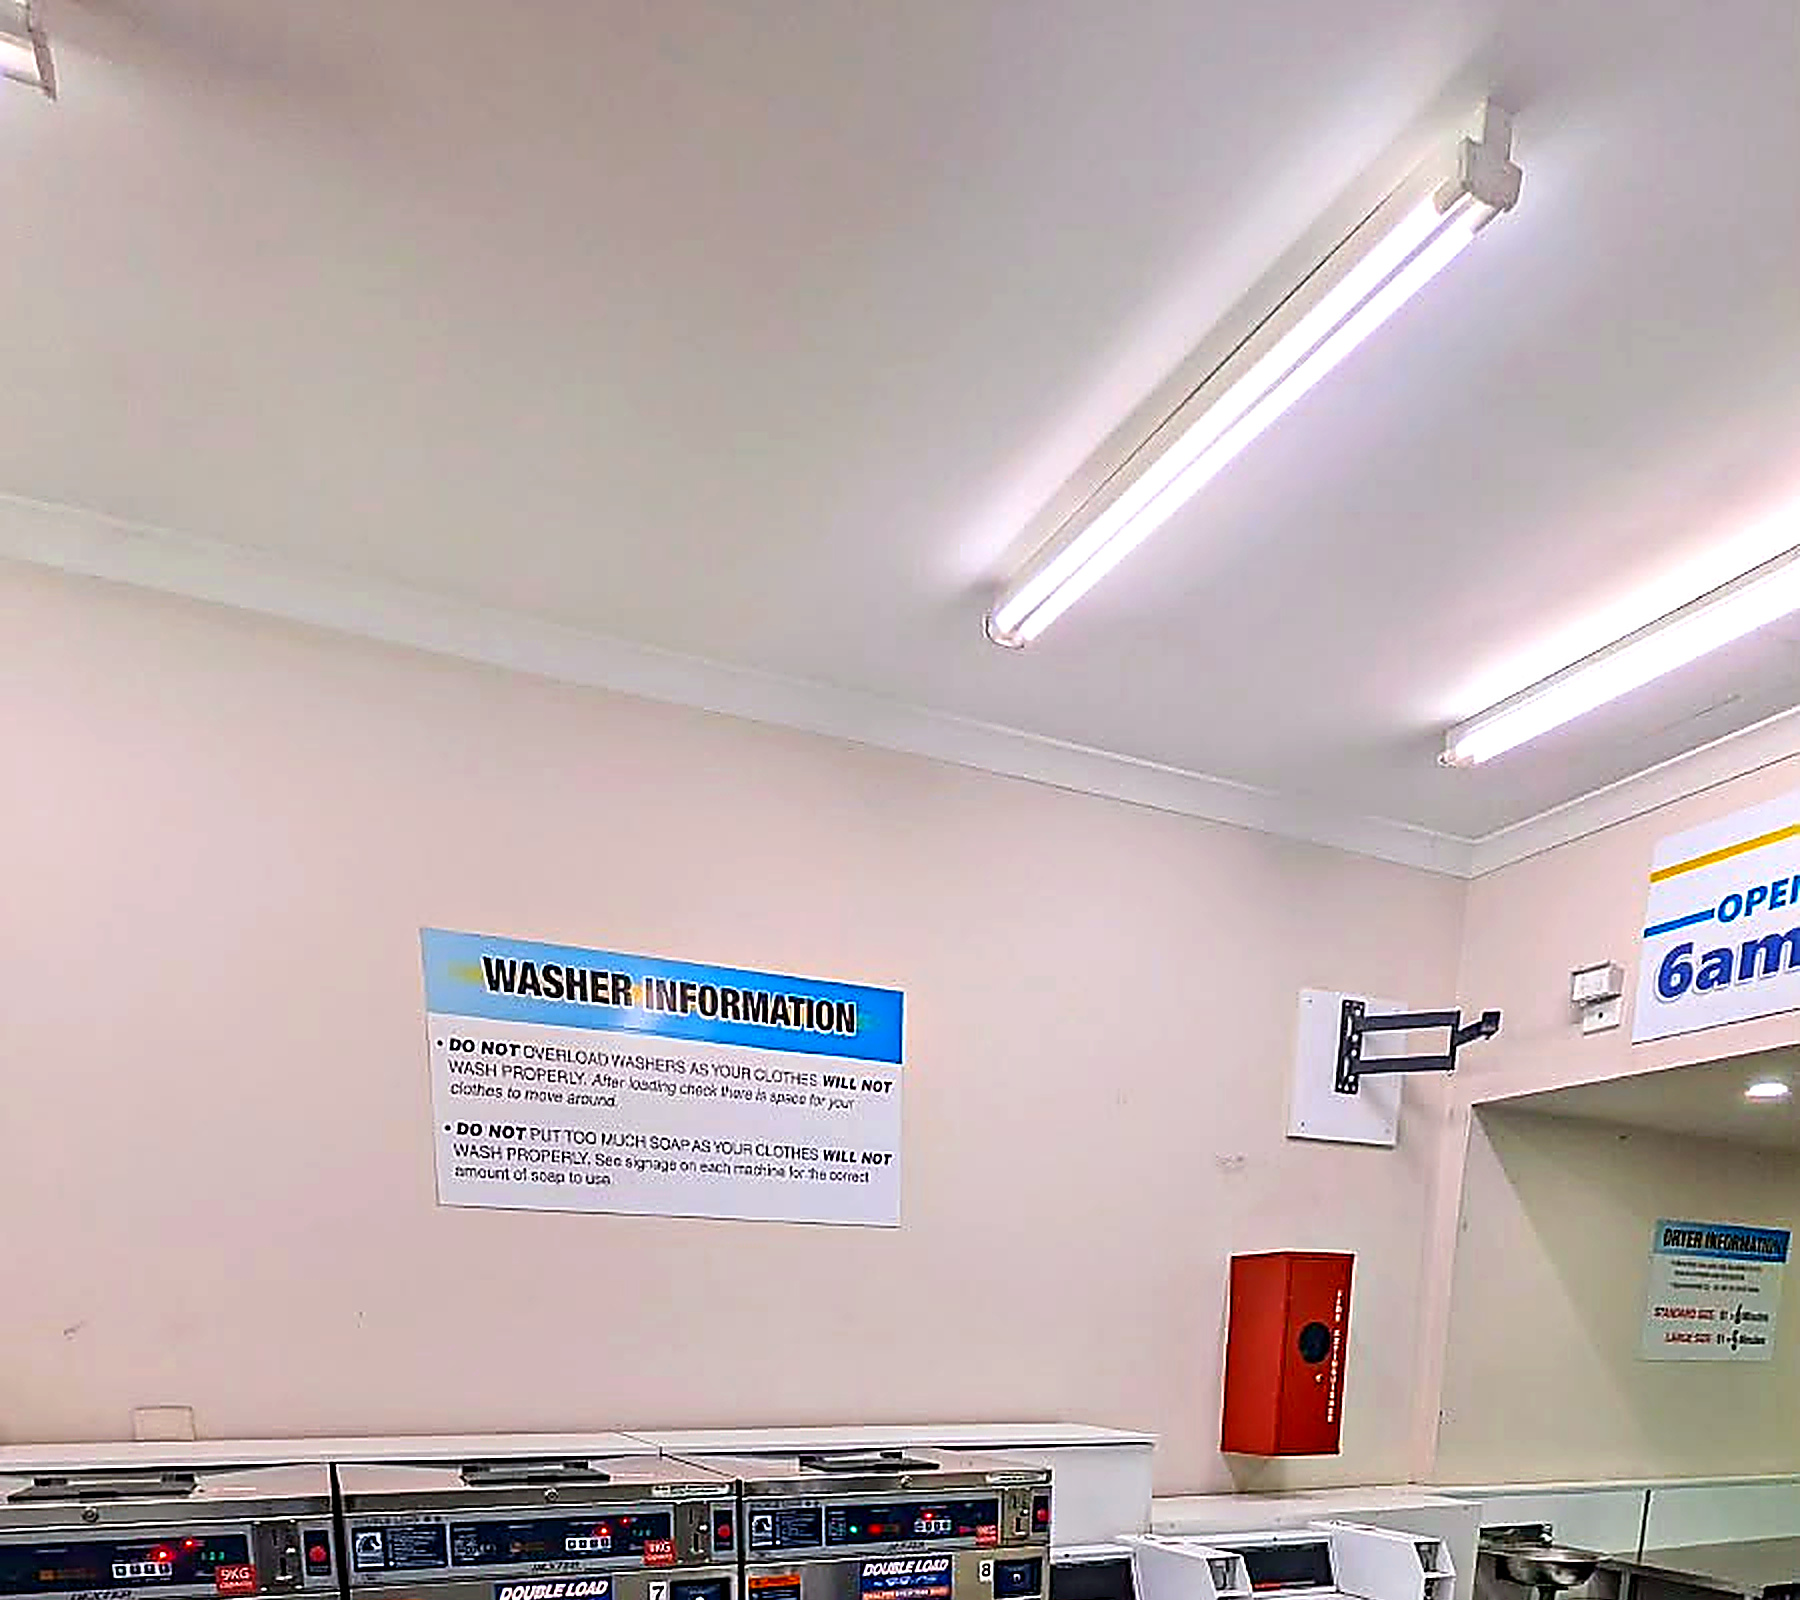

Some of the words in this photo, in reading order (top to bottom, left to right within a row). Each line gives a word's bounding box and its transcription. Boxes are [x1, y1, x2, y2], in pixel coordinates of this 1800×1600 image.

[1658, 927, 1800, 998] 6am
[482, 956, 634, 1007] WASHER
[644, 977, 857, 1034] INFORMATION
[448, 1059, 497, 1078] WASH
[501, 1064, 587, 1086] PROPERLY.
[591, 1073, 626, 1088] After
[629, 1076, 677, 1096] loading
[679, 1082, 718, 1098] check
[769, 1092, 805, 1107] space
[827, 1098, 855, 1112] your
[449, 1038, 475, 1053] DO
[482, 1041, 521, 1058] NOT
[523, 1045, 609, 1067] OVERLOAD
[611, 1054, 686, 1074] WASHERS
[690, 1062, 709, 1077] AS
[710, 1063, 752, 1081] YOUR
[753, 1068, 818, 1087] CLOTHES
[822, 1075, 857, 1091] WILL
[861, 1079, 893, 1094] NOT
[450, 1081, 503, 1098] clothes
[507, 1087, 521, 1100] to
[524, 1090, 563, 1104] move
[452, 1142, 503, 1160] WASH
[506, 1147, 591, 1167] PROPERLY.
[594, 1152, 622, 1168] See
[624, 1155, 677, 1173] signage
[679, 1160, 697, 1173] on
[699, 1161, 731, 1176] each
[733, 1164, 786, 1179] machine
[788, 1165, 804, 1180] for
[806, 1168, 827, 1181] the
[829, 1169, 870, 1183] correct
[456, 1122, 483, 1137] DO
[488, 1124, 527, 1141] NOT
[530, 1127, 563, 1144] PUT
[564, 1129, 597, 1146] TOO
[601, 1132, 647, 1149] MUCH
[649, 1136, 690, 1151] SOAP
[691, 1139, 710, 1153] AS
[712, 1140, 752, 1156] YOUR
[755, 1143, 819, 1161] CLOTHES
[822, 1149, 857, 1164] WILL
[861, 1151, 893, 1166] NOT
[454, 1165, 511, 1182] amount
[513, 1167, 528, 1182] of
[530, 1170, 565, 1185] soap
[568, 1171, 583, 1184] to
[565, 1580, 609, 1597] LOAD
[862, 1560, 916, 1577] DOUBLE
[981, 1563, 991, 1577] 8
